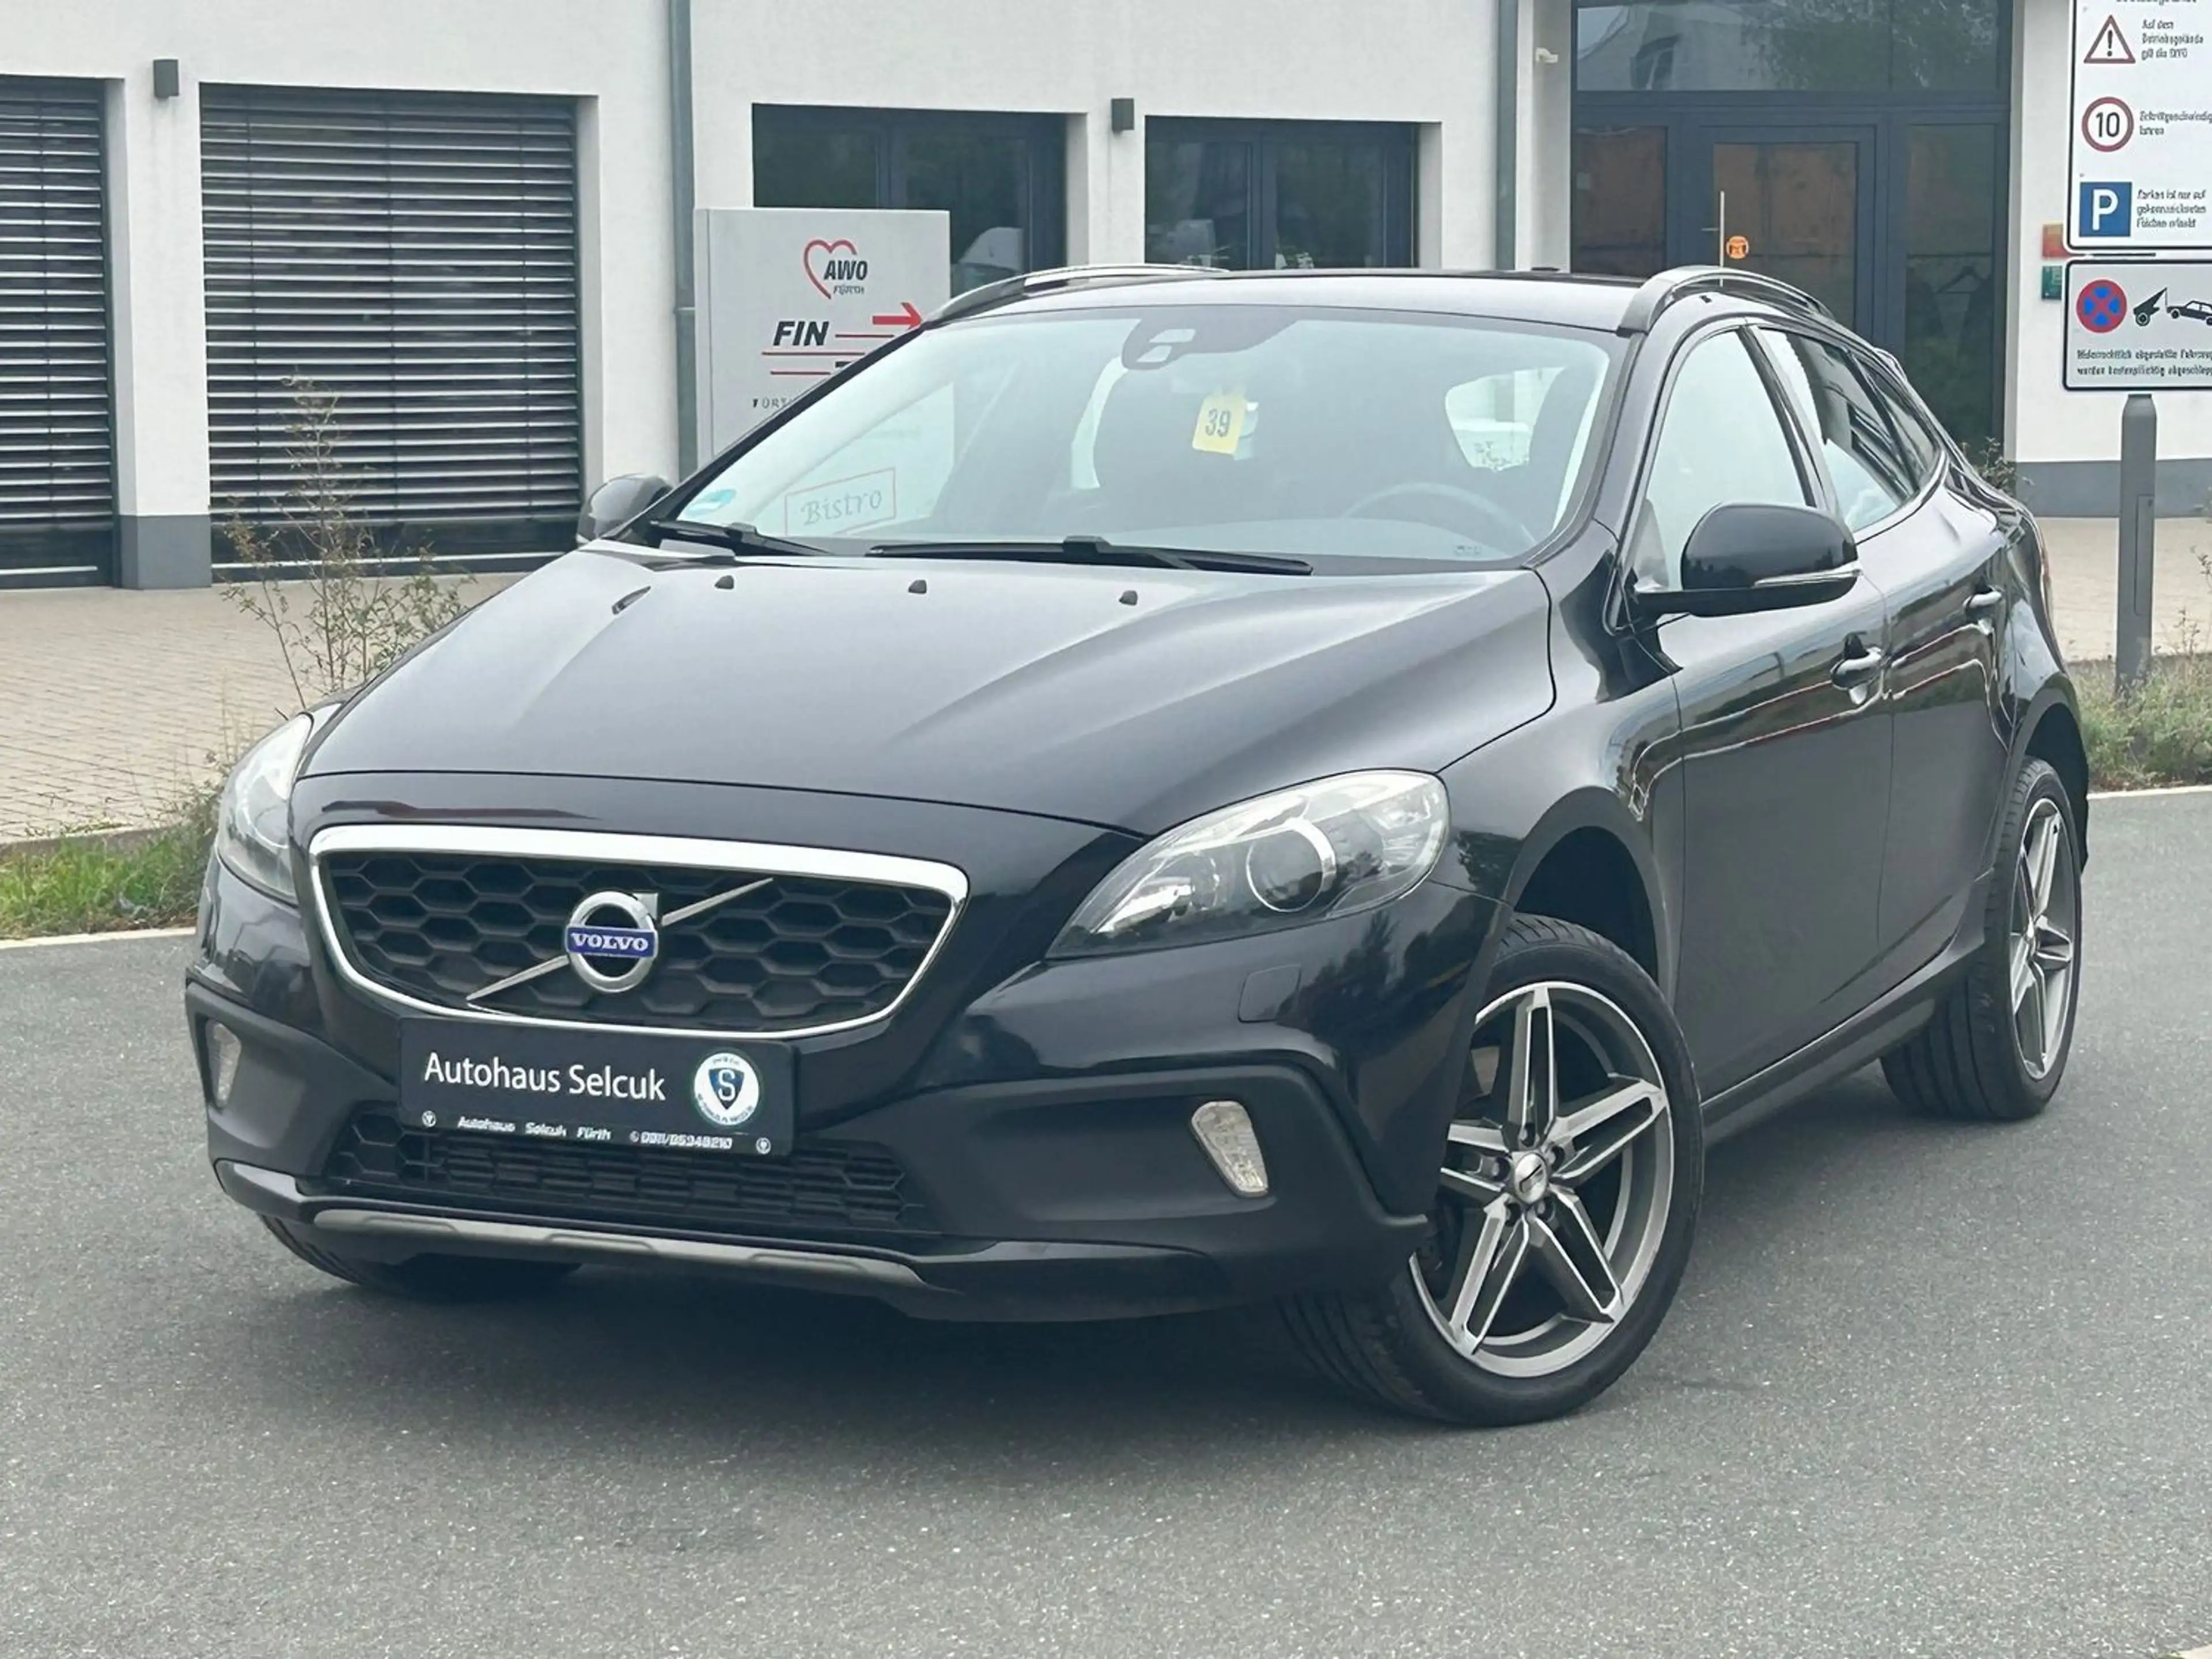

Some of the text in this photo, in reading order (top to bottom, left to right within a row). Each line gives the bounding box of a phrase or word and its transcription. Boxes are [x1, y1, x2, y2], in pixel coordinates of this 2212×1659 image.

[2096, 112, 2120, 137] 10
[2092, 188, 2119, 230] P
[824, 260, 868, 281] AWO
[773, 321, 830, 346] FIN
[1205, 408, 1231, 438] 39
[801, 490, 882, 525] Bistro
[570, 932, 649, 952] VOLVO
[425, 1052, 666, 1101] Autohaus Selcuk
[718, 1069, 736, 1101] S
